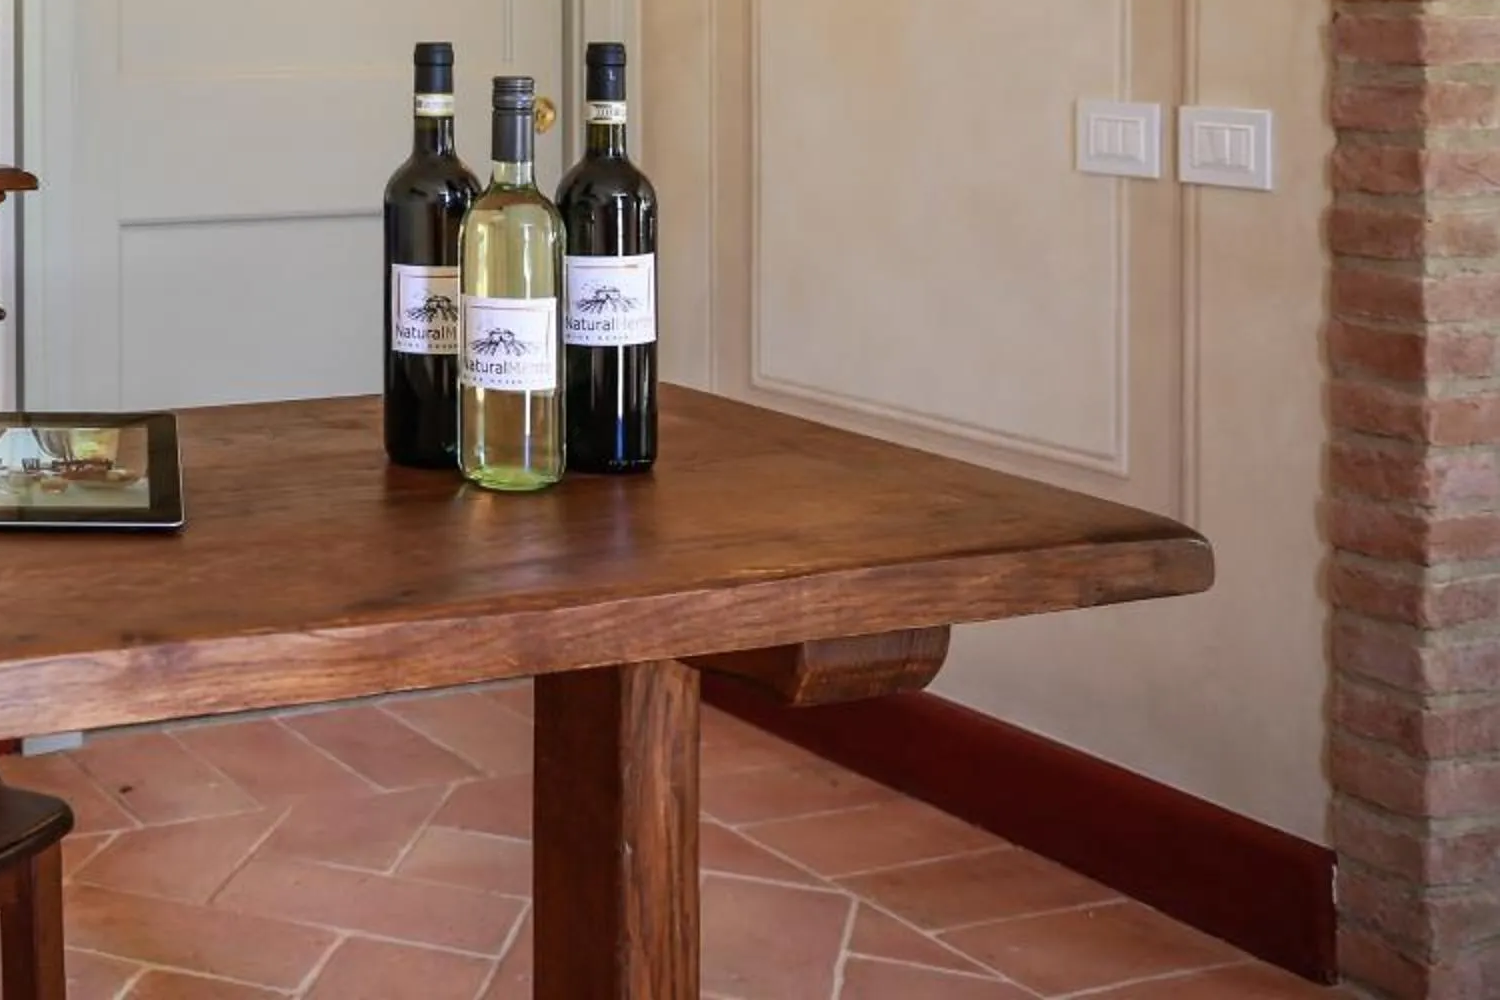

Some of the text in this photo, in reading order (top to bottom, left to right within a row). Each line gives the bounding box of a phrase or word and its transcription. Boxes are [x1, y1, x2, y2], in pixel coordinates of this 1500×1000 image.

[396, 324, 457, 340] NaturalM
[565, 316, 650, 332] NaturalMe
[463, 357, 550, 375] NaturalM
